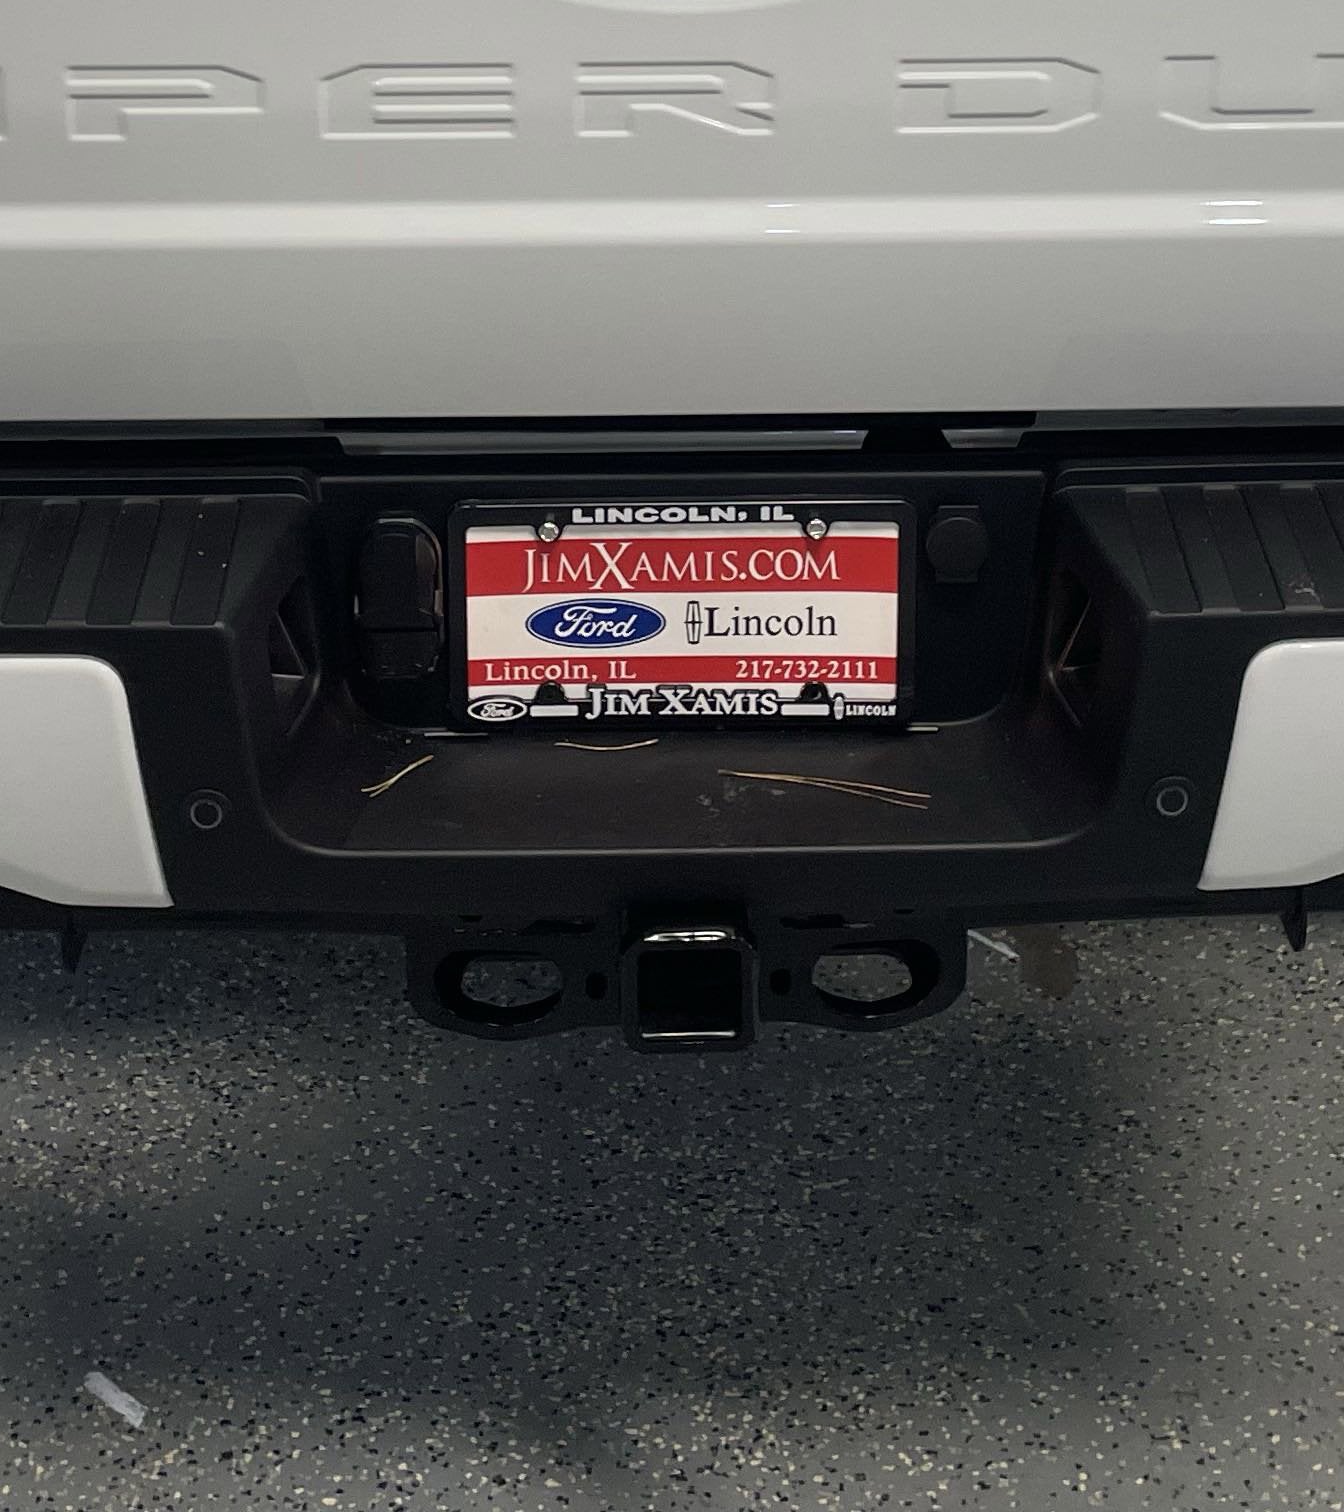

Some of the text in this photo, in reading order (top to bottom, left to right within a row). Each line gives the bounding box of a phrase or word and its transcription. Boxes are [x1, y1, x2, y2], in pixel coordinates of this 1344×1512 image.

[572, 505, 795, 524] LINCOLN, IL
[522, 542, 841, 593] JIMXAMIS.COM
[553, 606, 838, 638] Ford Lincoln
[484, 659, 879, 682] Lincoln, IL 217-732-2111
[585, 688, 650, 720] JIM
[657, 687, 778, 716] XAMIS
[845, 705, 897, 716] LINCOLN
